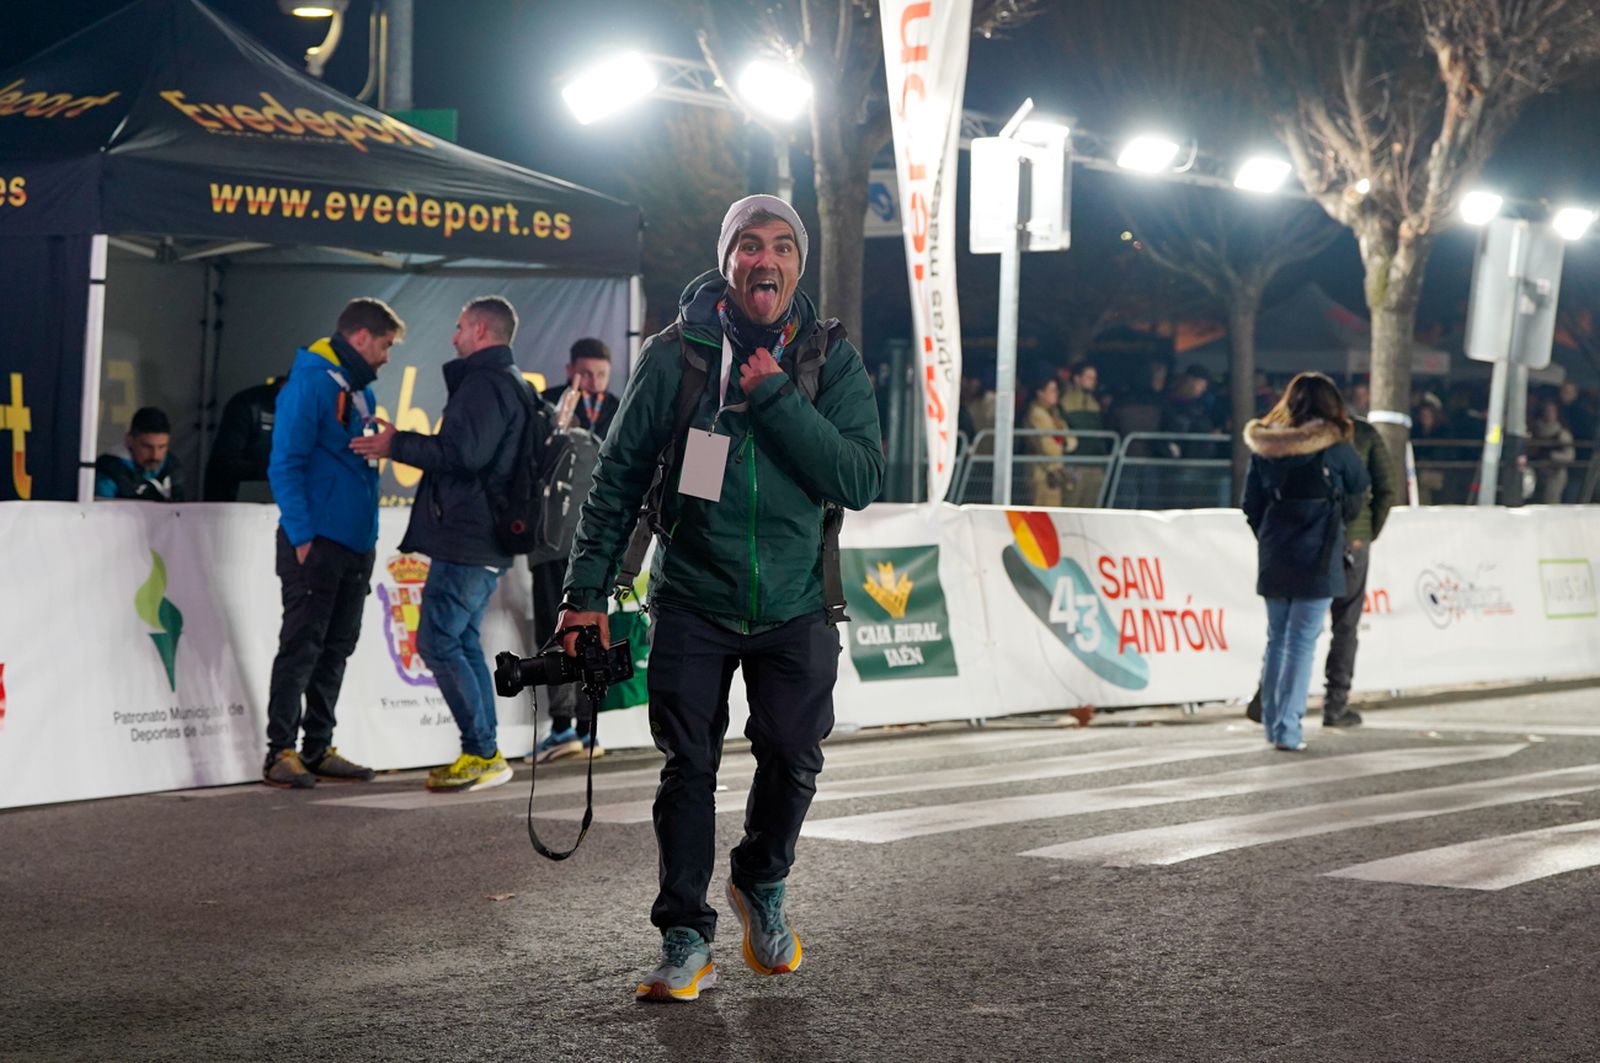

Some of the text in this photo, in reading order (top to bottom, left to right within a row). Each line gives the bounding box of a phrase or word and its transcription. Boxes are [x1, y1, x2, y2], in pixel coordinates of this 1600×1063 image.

[210, 182, 572, 241] www.evedeport.es
[1098, 555, 1164, 600] SAN
[856, 622, 943, 645] CAJA RURAL
[1049, 576, 1101, 653] 43
[1118, 594, 1229, 655] ANTÓN
[113, 711, 168, 724] Patronato
[228, 704, 245, 716] de
[131, 728, 181, 743] Deportes
[183, 727, 197, 738] de
